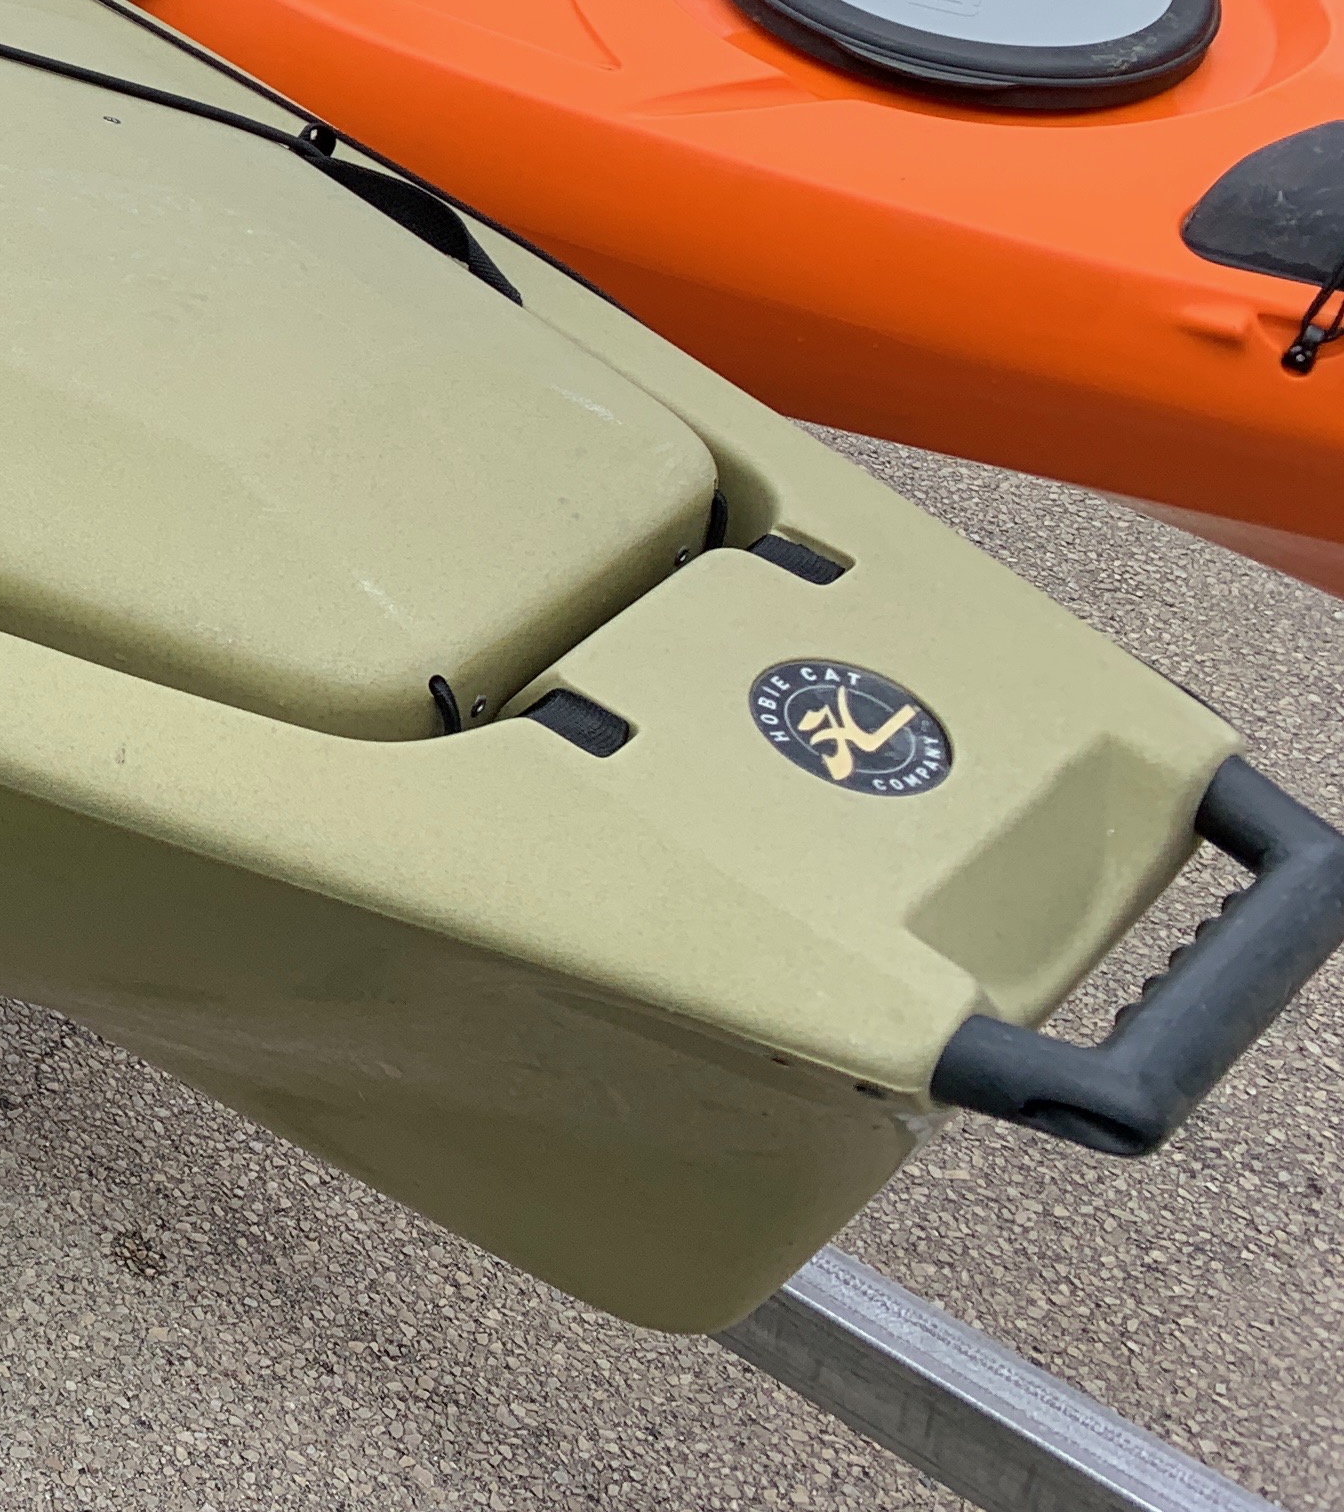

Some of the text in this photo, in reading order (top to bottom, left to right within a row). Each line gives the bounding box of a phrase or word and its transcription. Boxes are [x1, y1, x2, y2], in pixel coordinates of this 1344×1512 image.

[758, 666, 862, 744] HOBIE CAT
[871, 735, 944, 792] COMPANY
